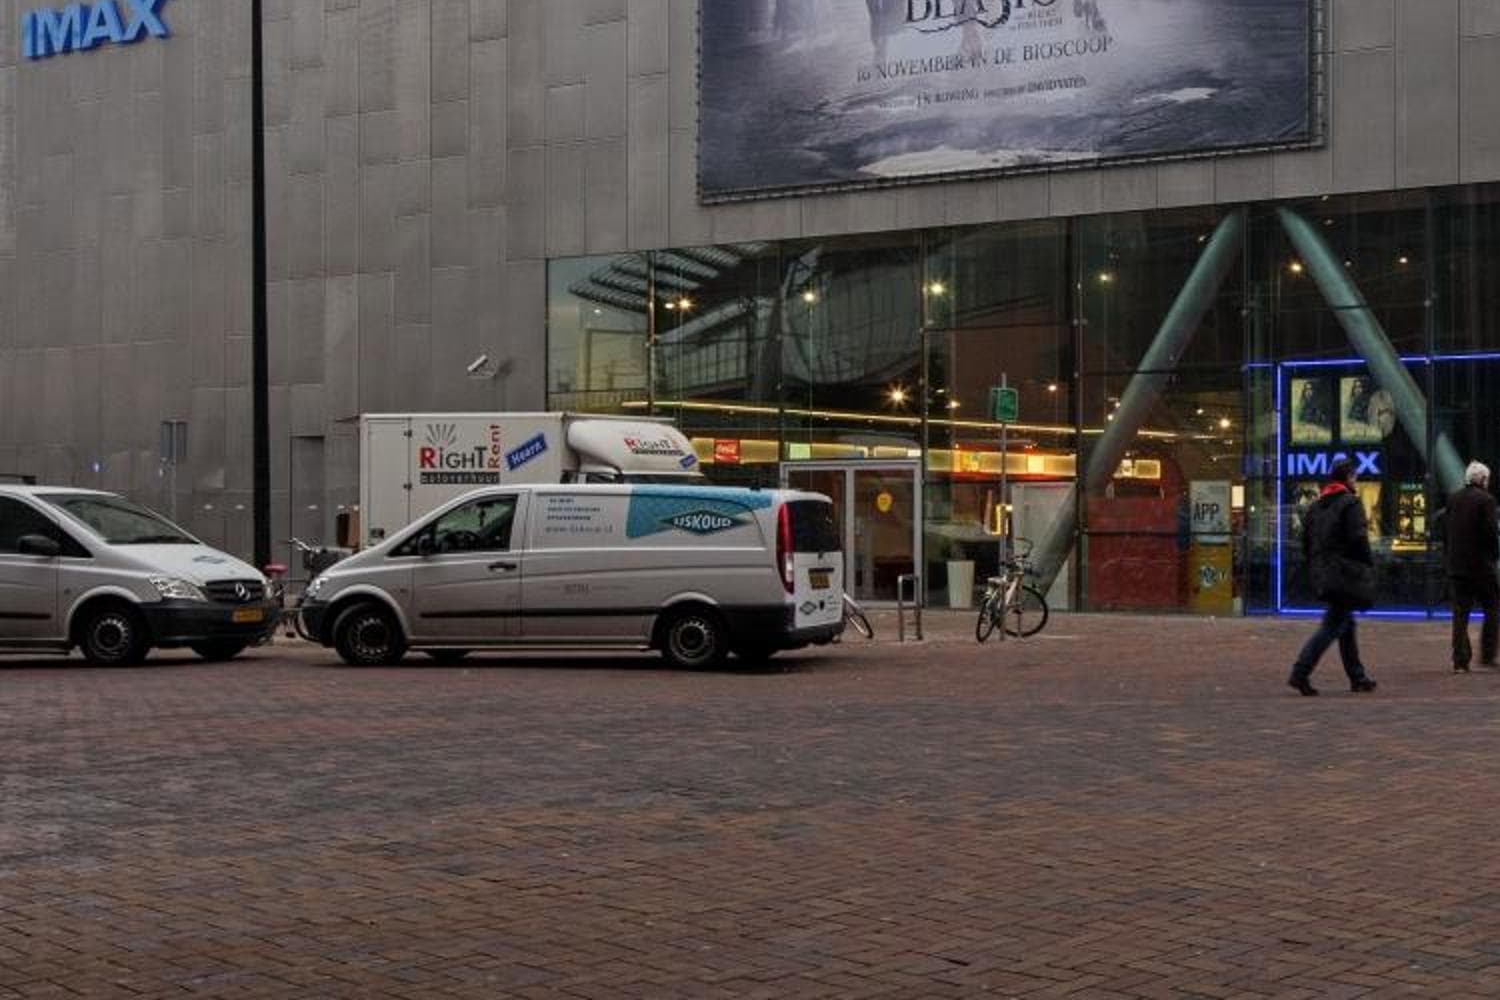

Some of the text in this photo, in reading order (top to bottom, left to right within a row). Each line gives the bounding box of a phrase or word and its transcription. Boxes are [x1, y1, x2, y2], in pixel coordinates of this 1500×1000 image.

[877, 54, 964, 79] NOVEMBER
[994, 47, 1016, 65] DE
[1023, 35, 1113, 61] BIOSCOOP
